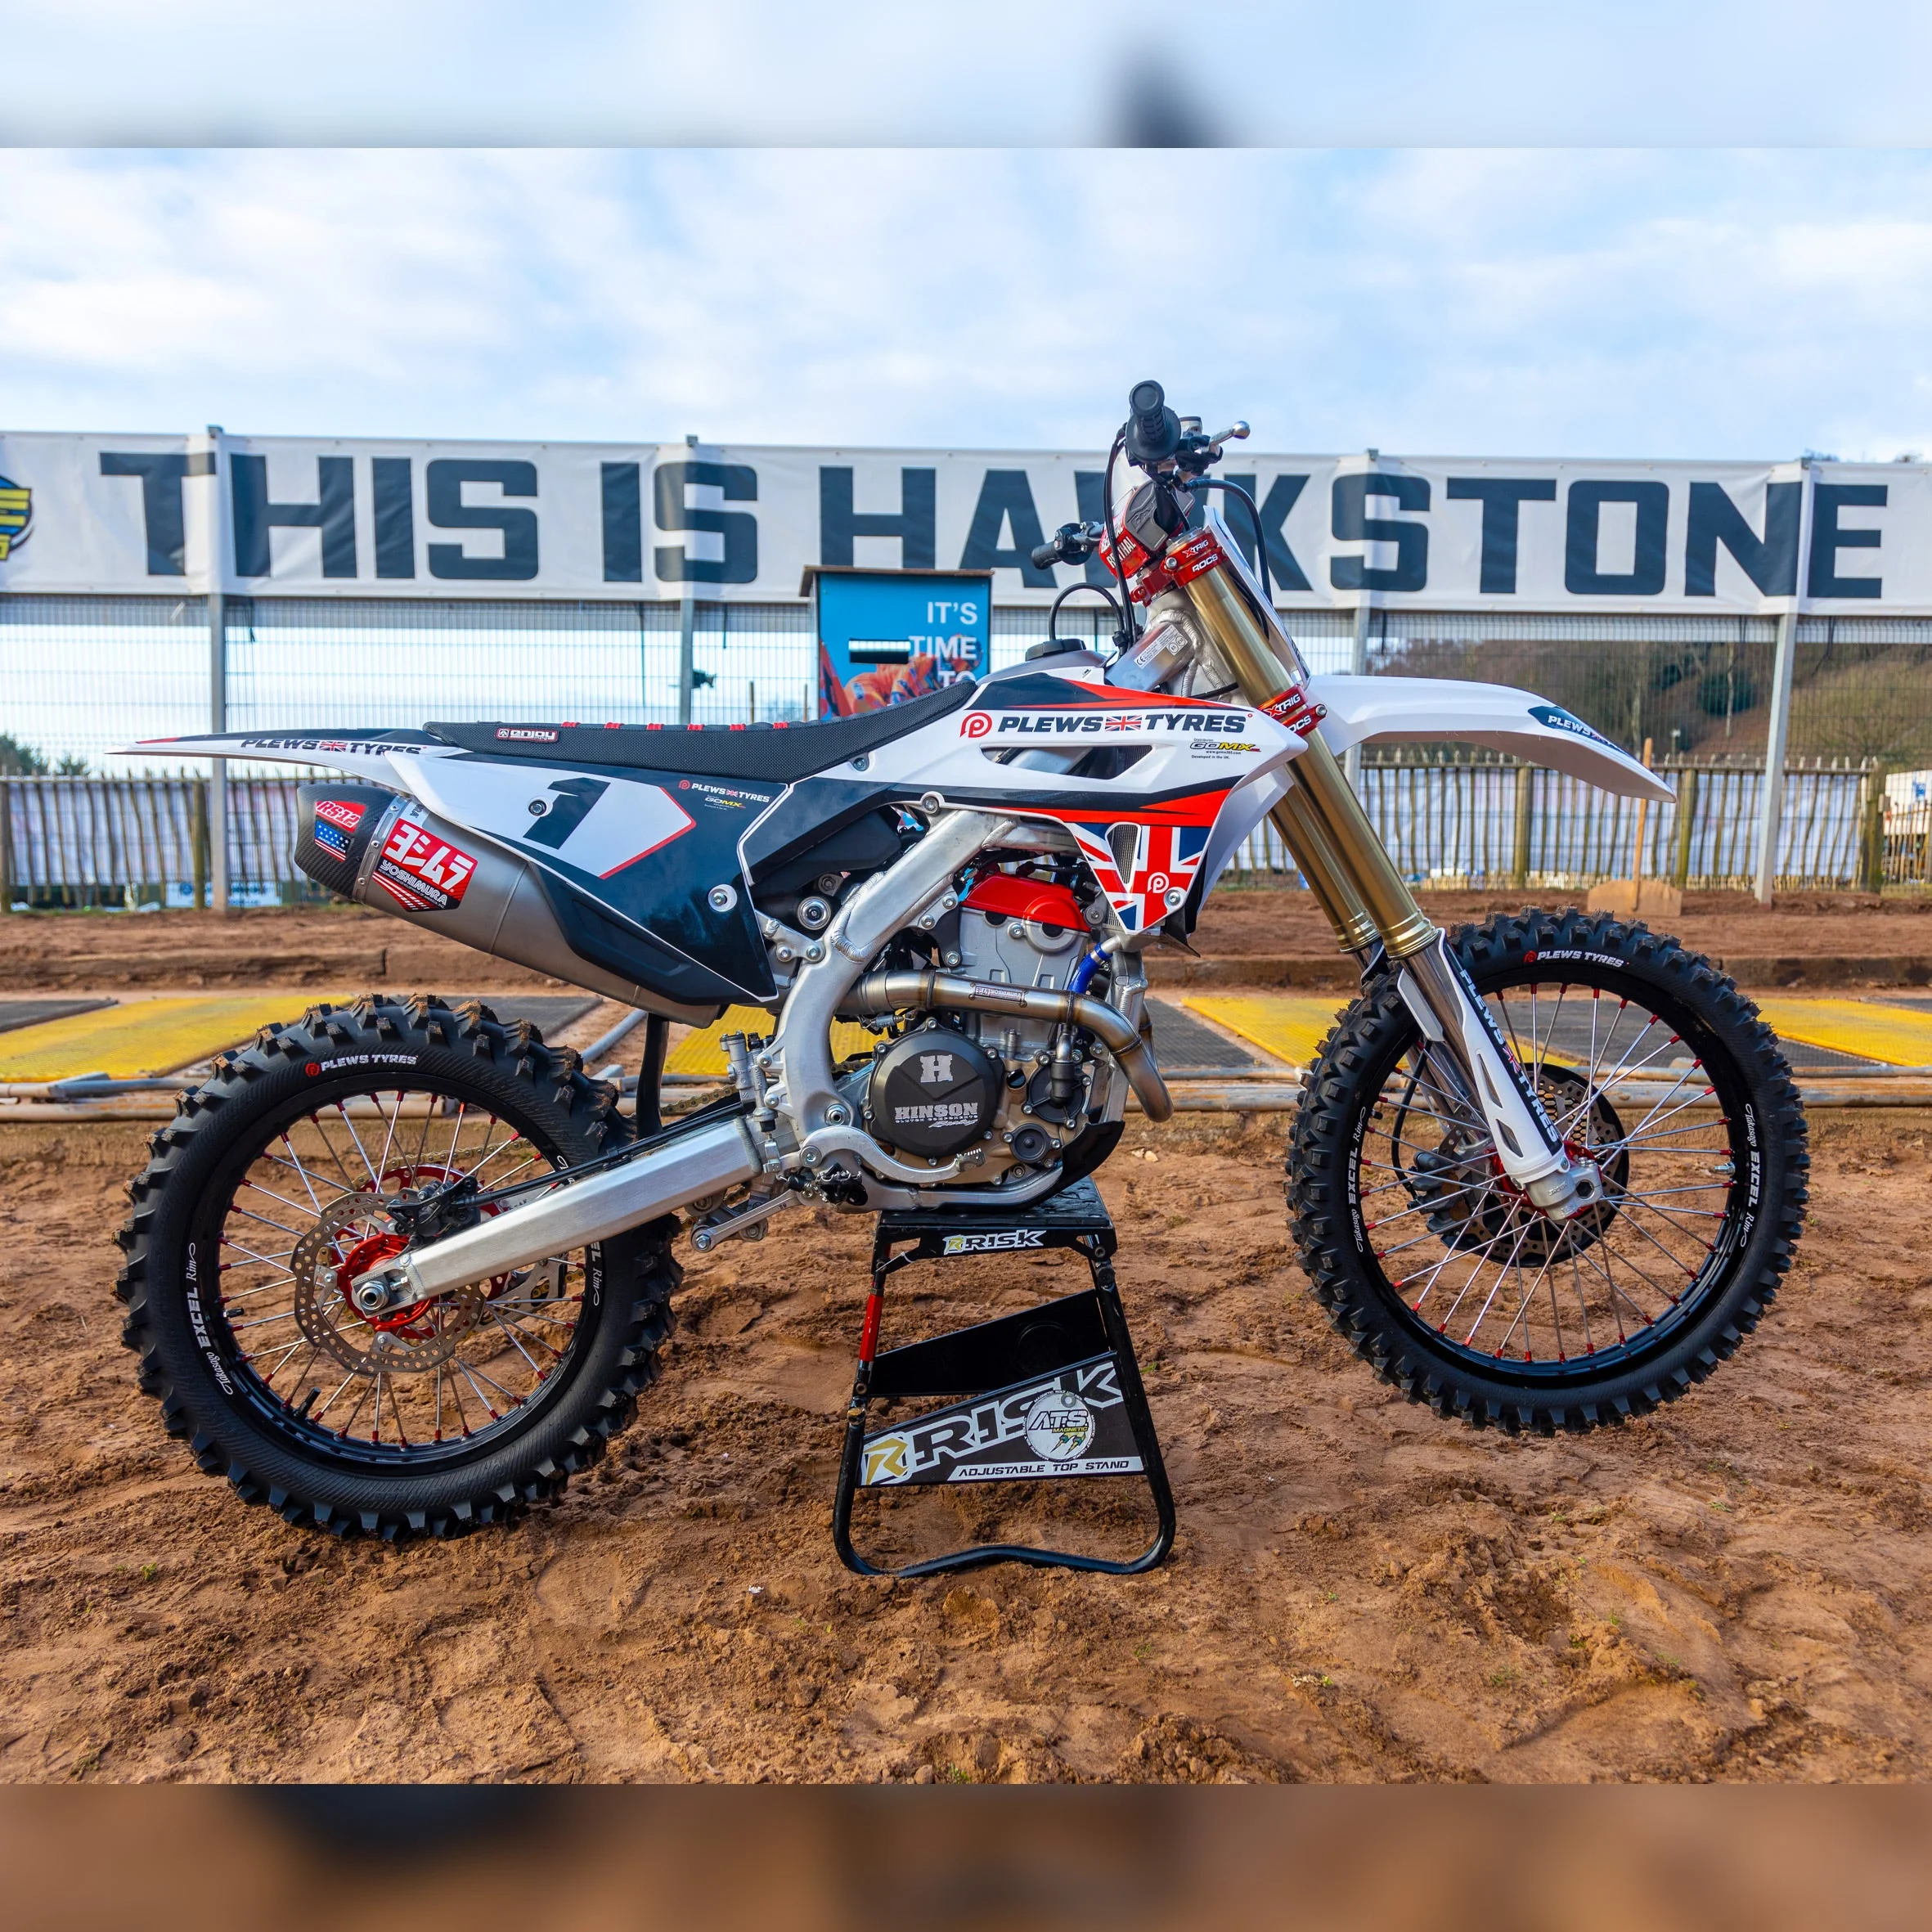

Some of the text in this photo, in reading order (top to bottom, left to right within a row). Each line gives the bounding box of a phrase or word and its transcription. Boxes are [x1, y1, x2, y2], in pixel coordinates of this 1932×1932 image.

[100, 452, 538, 580] THIS
[601, 461, 757, 584] IS
[1182, 540, 1209, 559] XTRIG
[1192, 554, 1218, 572] ROCS
[928, 602, 977, 624] IT'S
[908, 636, 977, 658] TIME
[1263, 694, 1301, 717] XTRIG
[998, 717, 1103, 733] PLEWS
[1145, 714, 1247, 734] TYRES
[1288, 715, 1312, 732] OCS
[240, 739, 320, 750] PLEWS
[691, 783, 770, 802] PLEWS TYRES
[523, 777, 611, 850] 1
[380, 859, 448, 905] YOSHIMURA
[1537, 950, 1624, 968] PLEWS TYRES
[321, 1054, 416, 1072] PLEWS TYRES
[1461, 968, 1559, 1143] PLEWS TYRES
[919, 1054, 953, 1083] H
[894, 1102, 978, 1119] HINSON
[1347, 1107, 1366, 1253] Takasago EXCEL Rim
[1740, 1103, 1760, 1247] Takasago EXCEL Rim
[964, 1229, 1047, 1250] RISK
[593, 1268, 602, 1306] Rim
[186, 1242, 234, 1395] Takasago EXCEL Rim
[959, 1460, 1129, 1476] ADJUSTABLE TOP STAND
